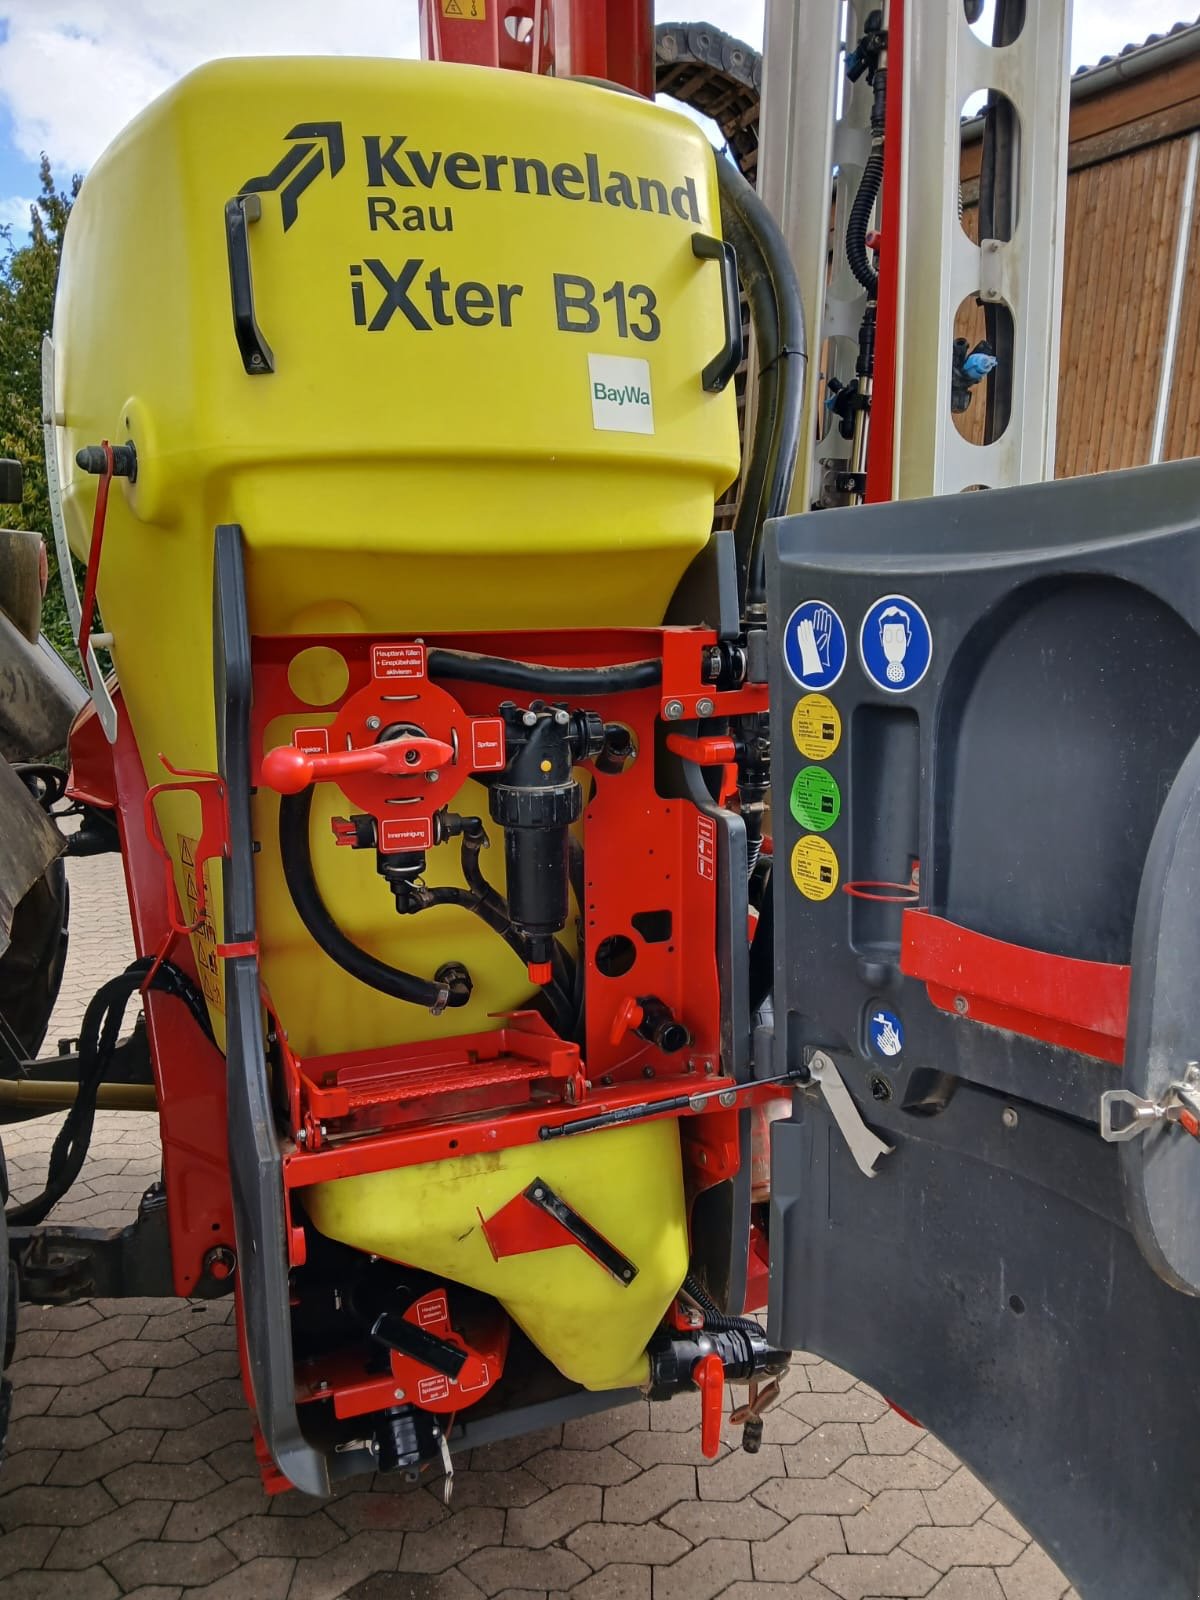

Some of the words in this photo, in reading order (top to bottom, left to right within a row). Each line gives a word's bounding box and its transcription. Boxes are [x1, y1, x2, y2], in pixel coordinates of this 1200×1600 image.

[362, 136, 702, 224] Kverneland
[367, 197, 454, 231] Rau
[350, 259, 524, 331] iXter
[553, 273, 661, 342] B13
[594, 383, 650, 405] BayWa
